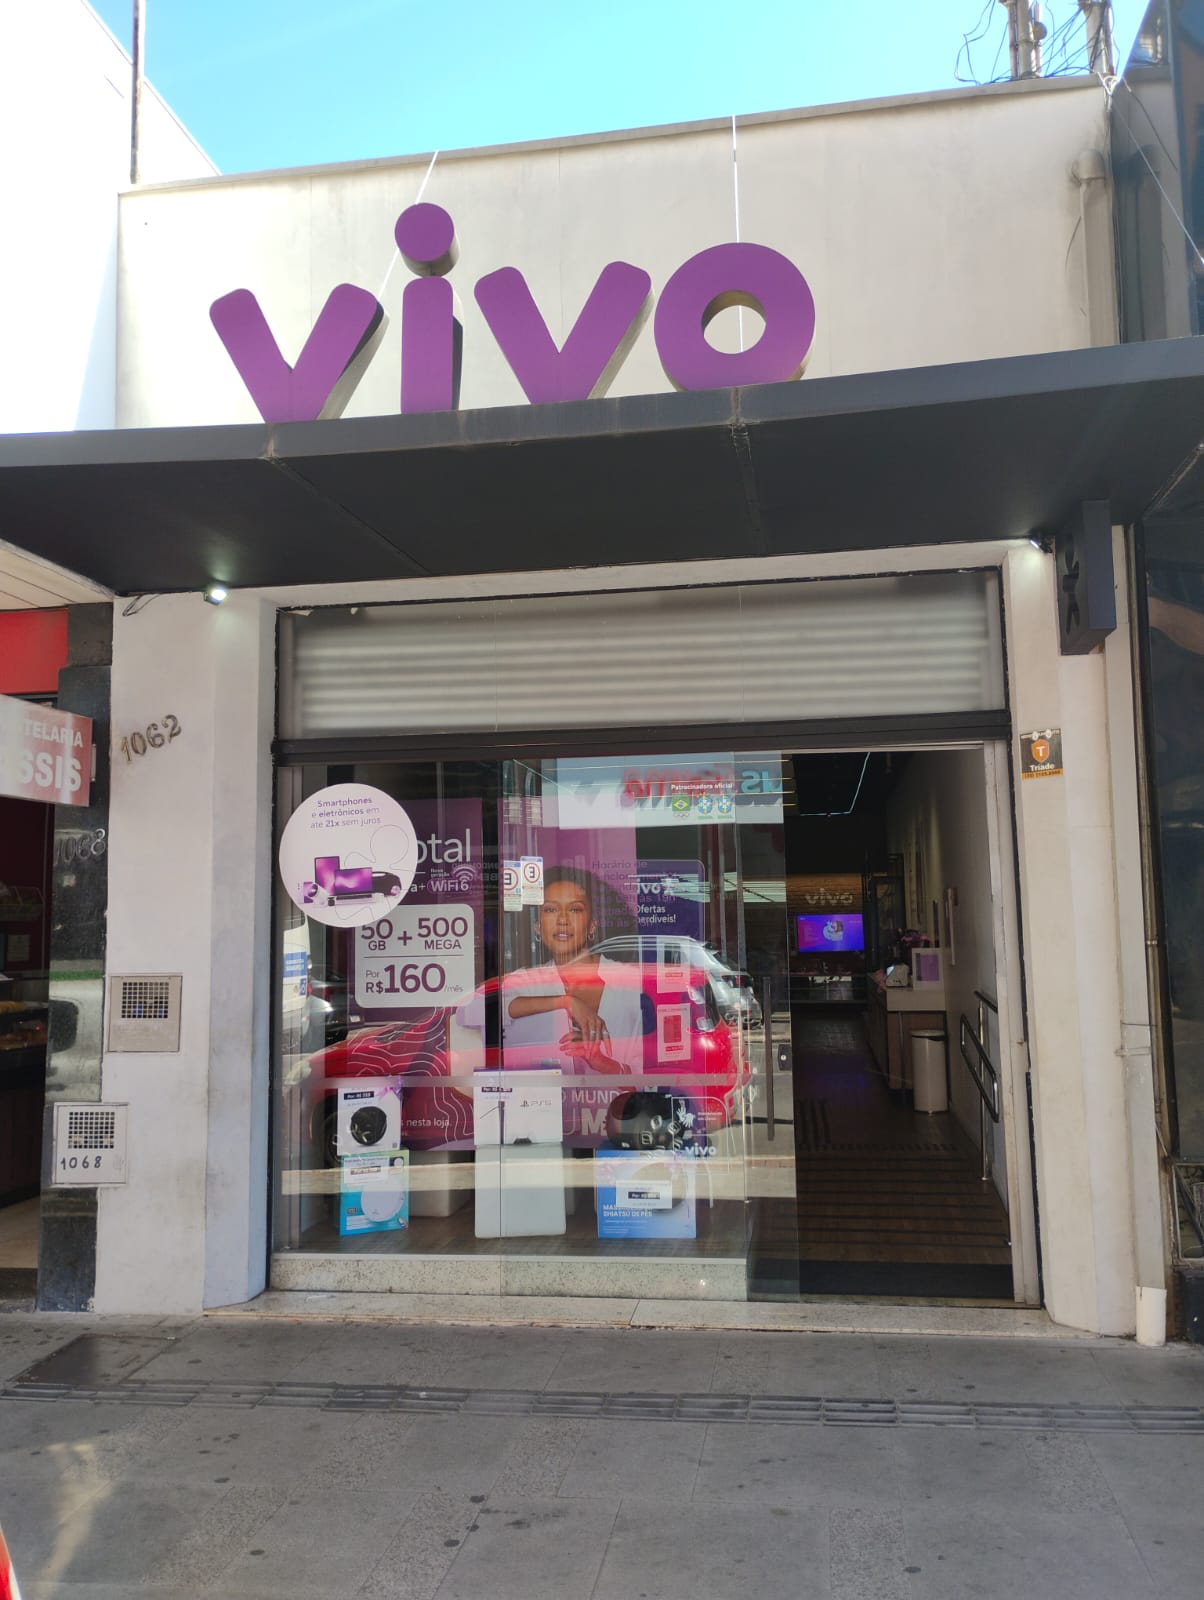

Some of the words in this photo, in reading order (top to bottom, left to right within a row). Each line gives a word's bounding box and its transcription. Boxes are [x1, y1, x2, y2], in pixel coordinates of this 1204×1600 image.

[209, 202, 818, 424] vivo
[23, 719, 84, 748] TELARIA
[121, 714, 182, 762] 1062
[17, 749, 82, 793] SSIS
[317, 797, 372, 807] Smartphones
[318, 808, 364, 818] eletrônicos
[310, 821, 325, 829] até
[325, 820, 340, 828] 21x
[360, 817, 381, 827] juros
[53, 828, 106, 865] 1068
[636, 879, 661, 895] ivo
[805, 888, 853, 906] vivo
[361, 919, 394, 940] 50
[417, 916, 468, 938] 500
[368, 940, 386, 951] GB
[424, 939, 462, 951] MEGA
[365, 969, 380, 978] Por
[384, 963, 446, 993] 160
[571, 1089, 630, 1104] MUND
[406, 1118, 432, 1127] nesta
[684, 1142, 717, 1156] vivo
[60, 1156, 102, 1171] 1068
